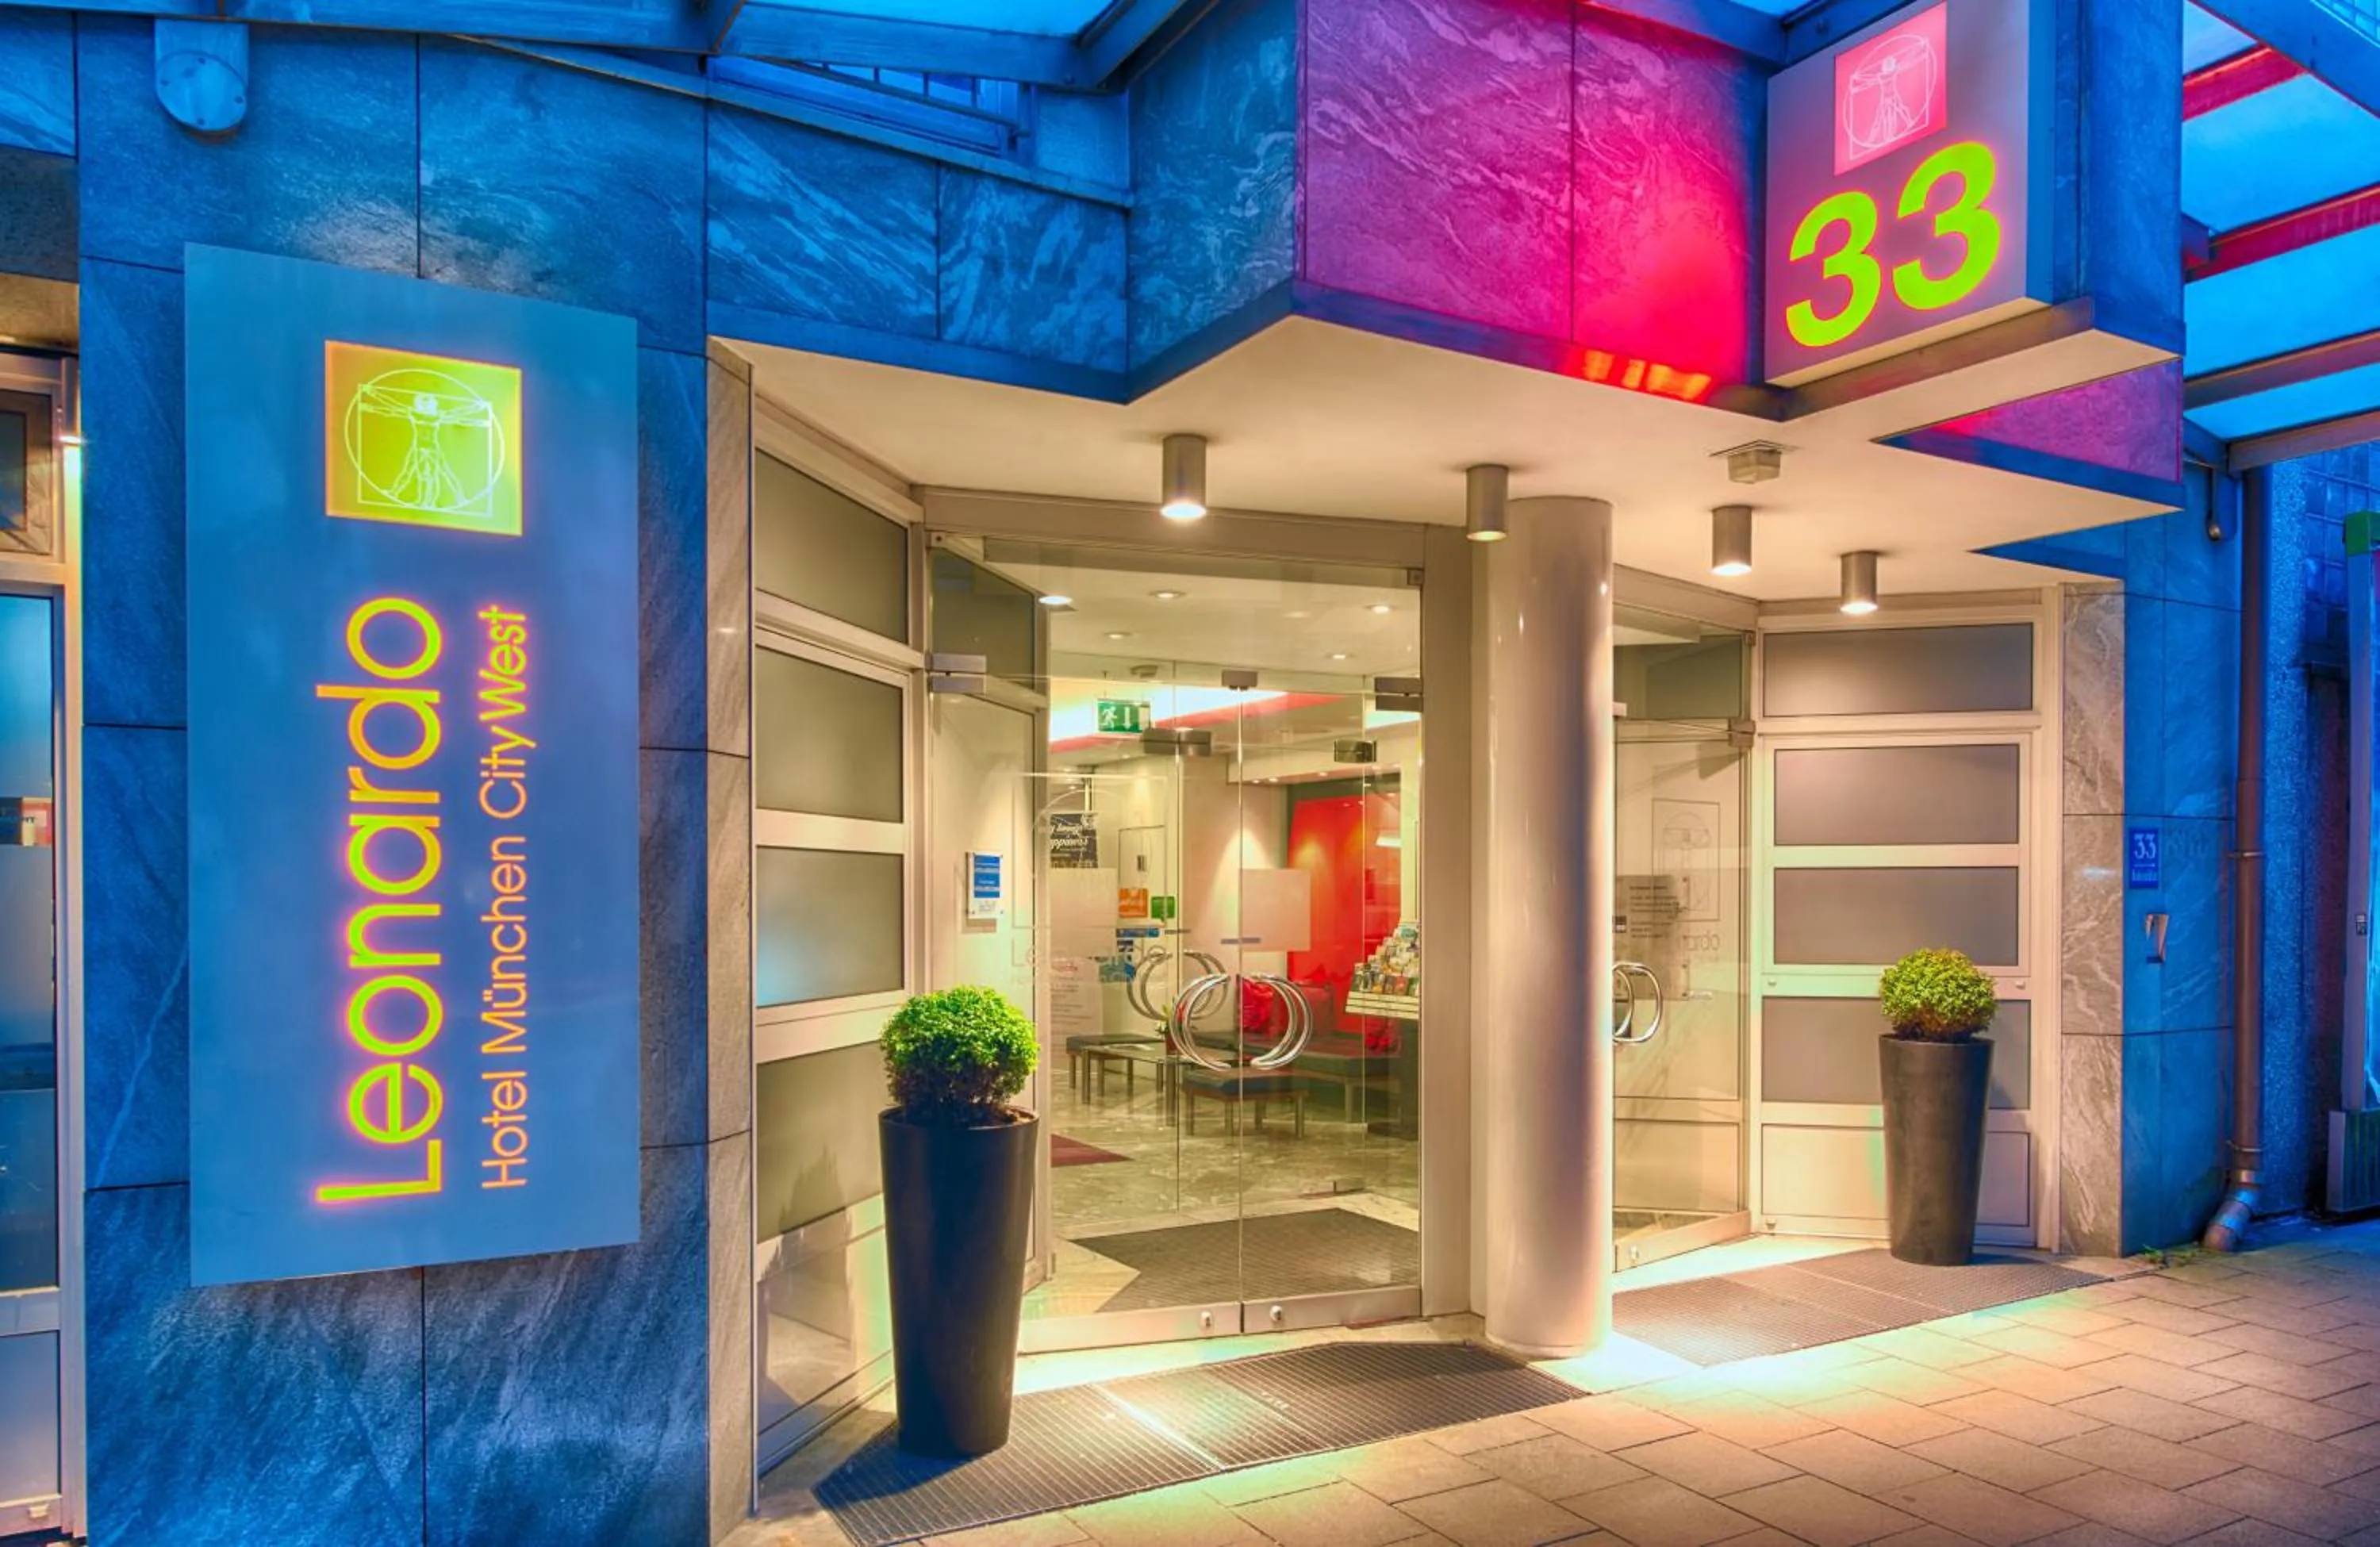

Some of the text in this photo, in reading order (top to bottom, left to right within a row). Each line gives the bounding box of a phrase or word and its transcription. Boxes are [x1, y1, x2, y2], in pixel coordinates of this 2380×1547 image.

[1786, 141, 2001, 347] 33
[316, 597, 443, 1203] Leonardo
[481, 837, 527, 1054] München
[2133, 833, 2156, 859] 33
[482, 1071, 528, 1189] Hotel
